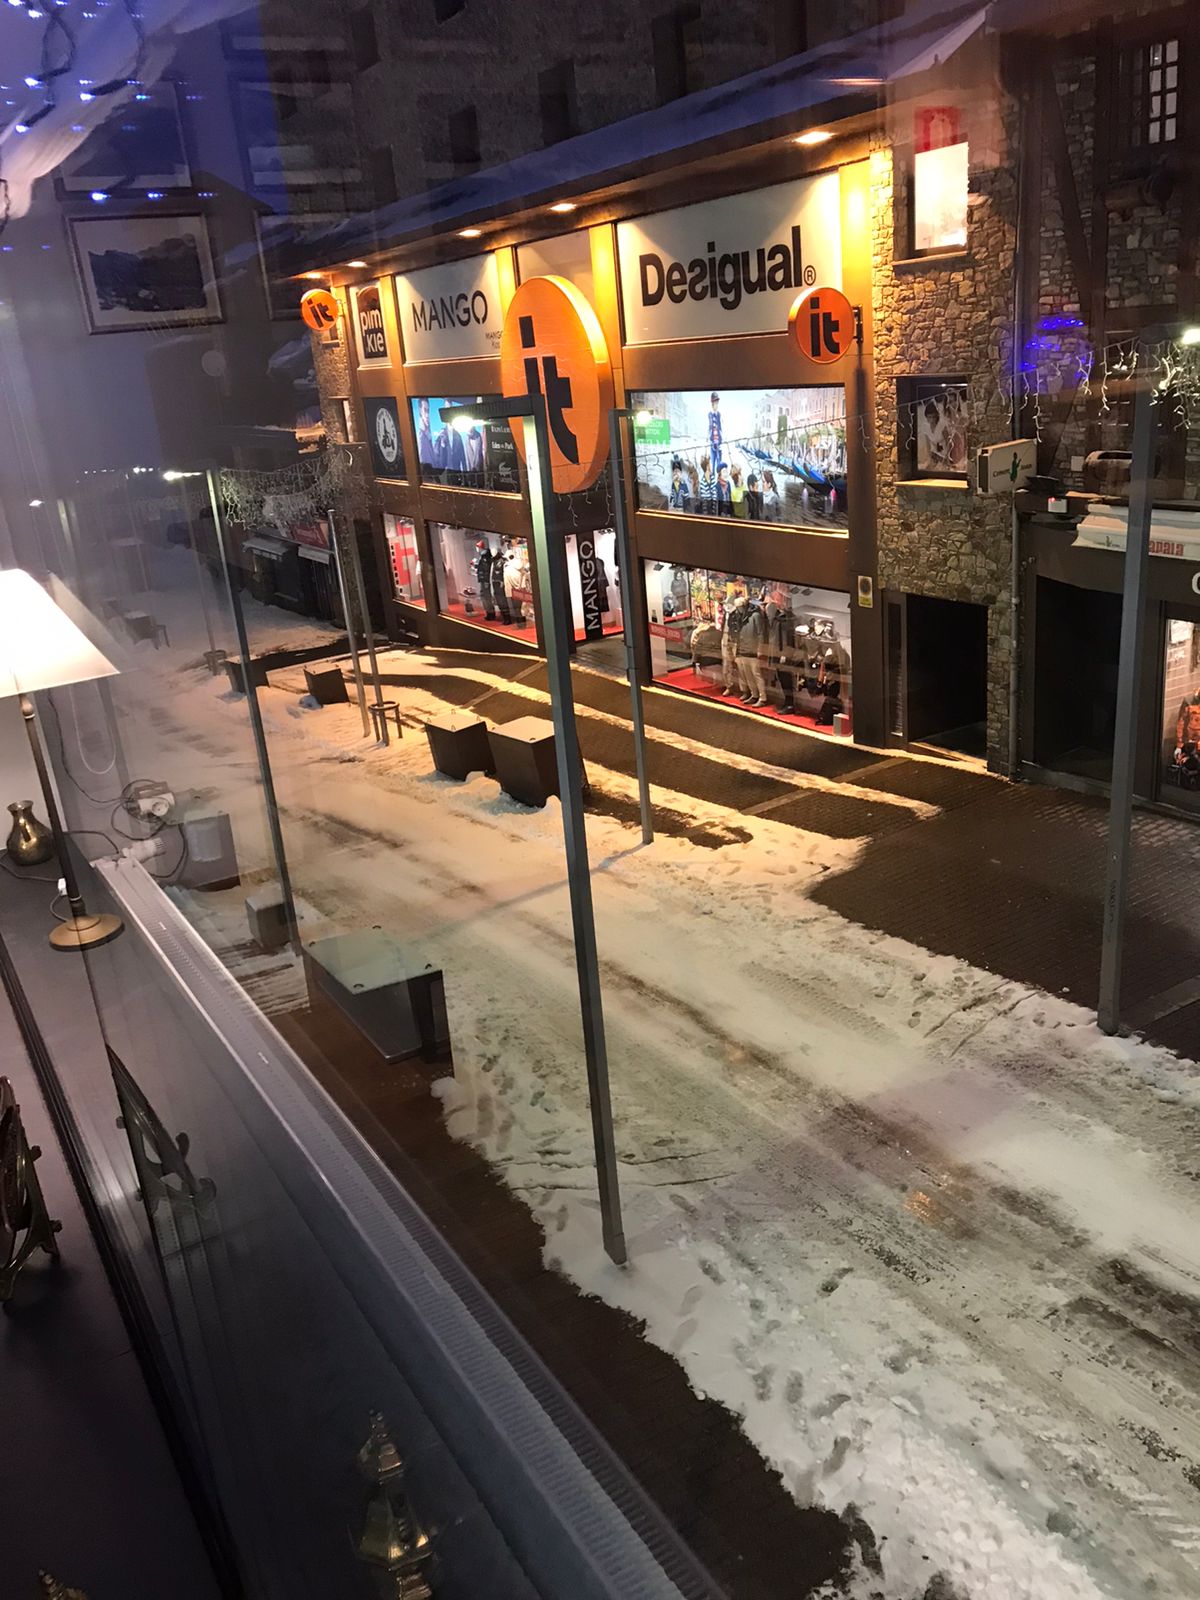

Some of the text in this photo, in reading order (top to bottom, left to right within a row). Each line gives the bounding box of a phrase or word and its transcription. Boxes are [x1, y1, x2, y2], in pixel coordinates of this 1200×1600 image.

[638, 224, 803, 310] Desigual
[306, 298, 334, 328] it
[411, 289, 488, 333] MANGO
[810, 296, 840, 357] it
[518, 315, 580, 465] it
[579, 541, 601, 630] MANGO
